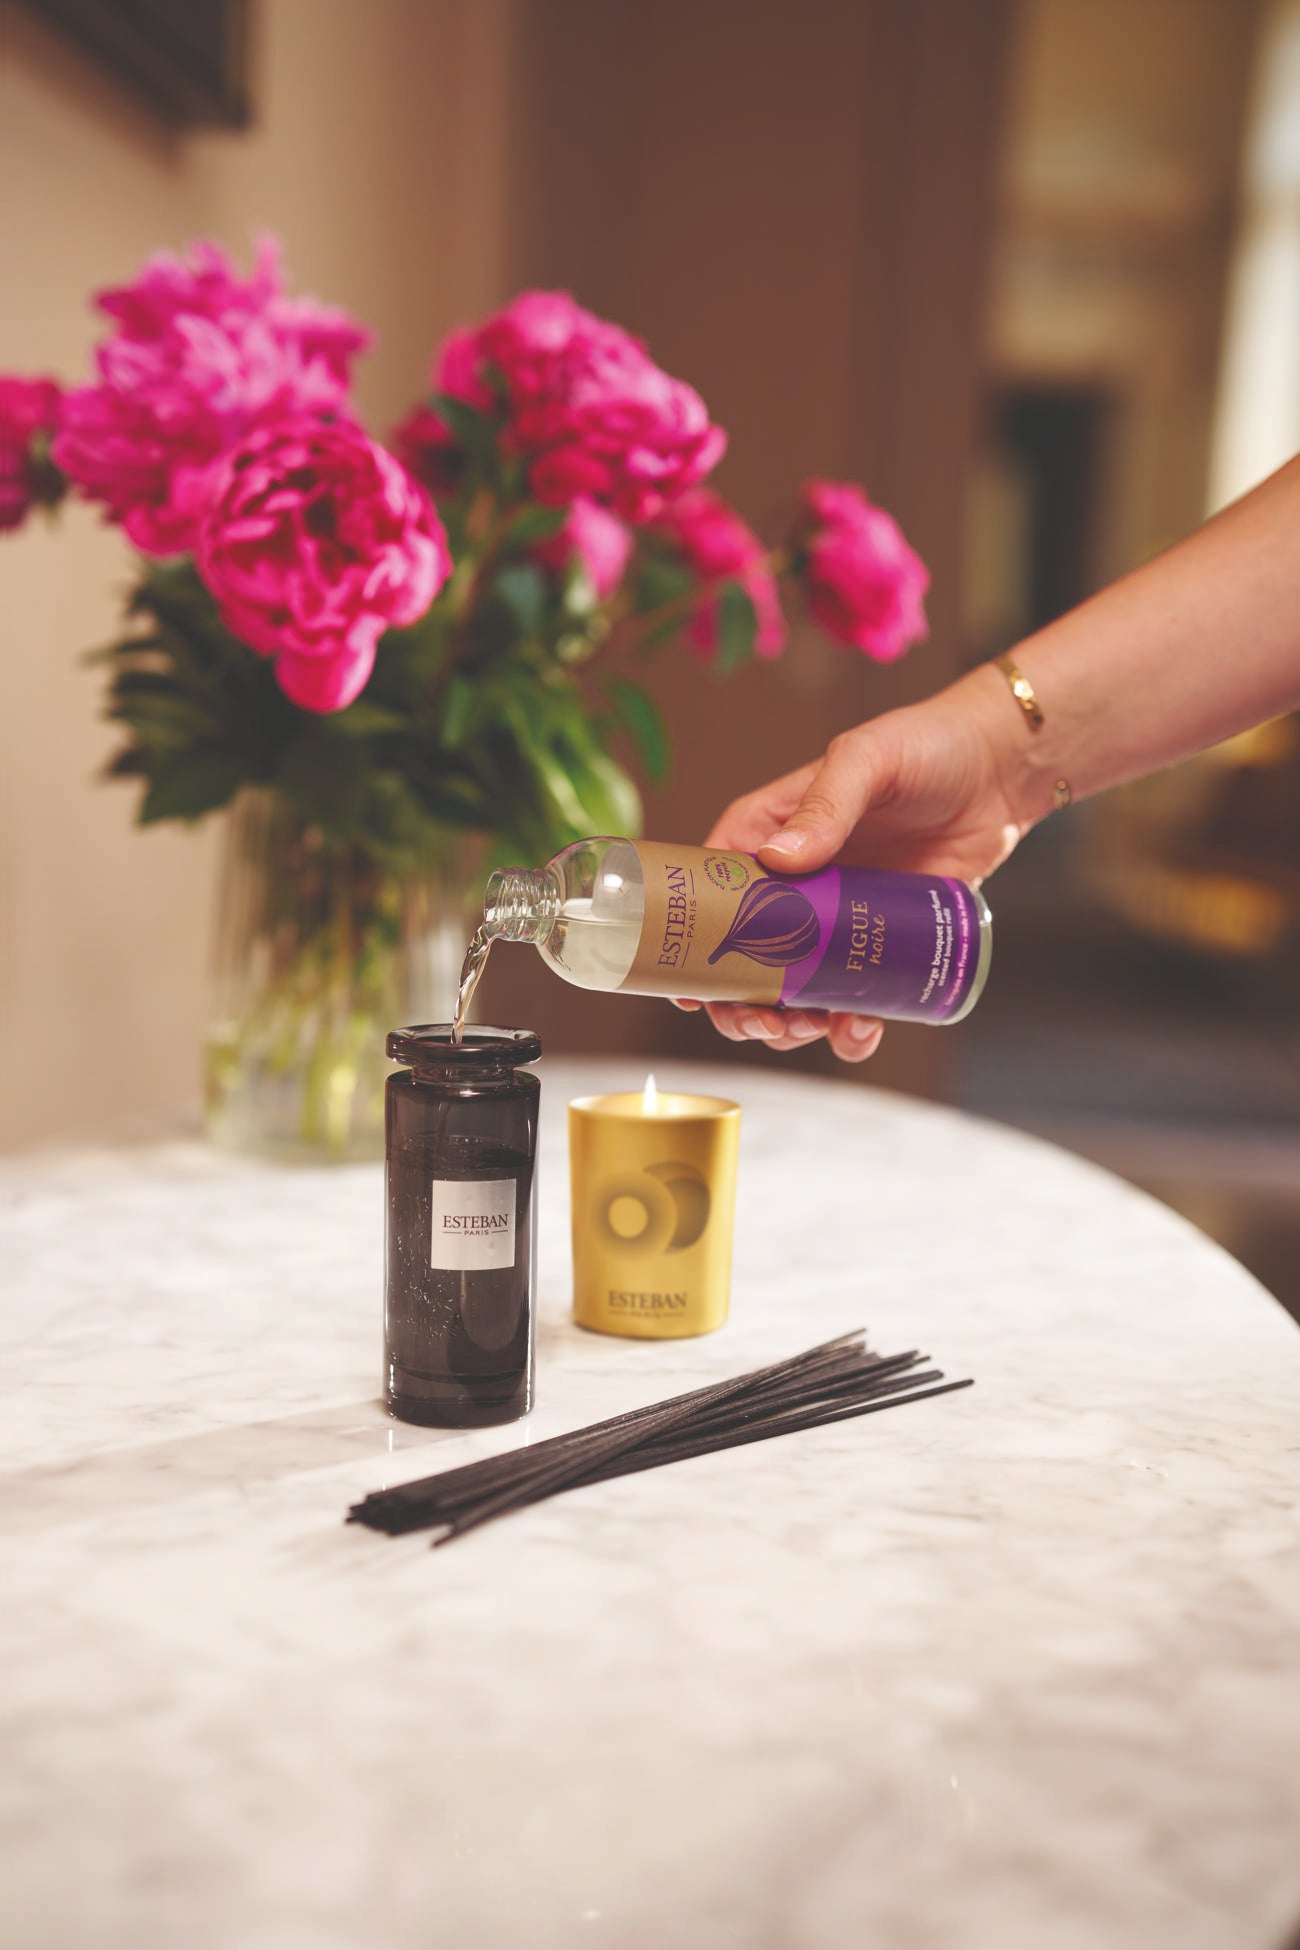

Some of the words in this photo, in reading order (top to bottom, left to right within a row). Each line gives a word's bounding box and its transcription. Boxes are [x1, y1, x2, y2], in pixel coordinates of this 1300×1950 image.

[657, 864, 687, 968] ESTEBAN
[687, 900, 696, 938] PARIS
[846, 900, 869, 971] FIGUE
[868, 914, 886, 966] noire
[920, 967, 939, 1003] recharge
[931, 925, 945, 966] bouquet
[938, 958, 950, 986] scented
[944, 925, 954, 957] bouquet
[443, 1214, 508, 1229] ESTEBAN
[608, 1290, 688, 1309] ESTEBAN
